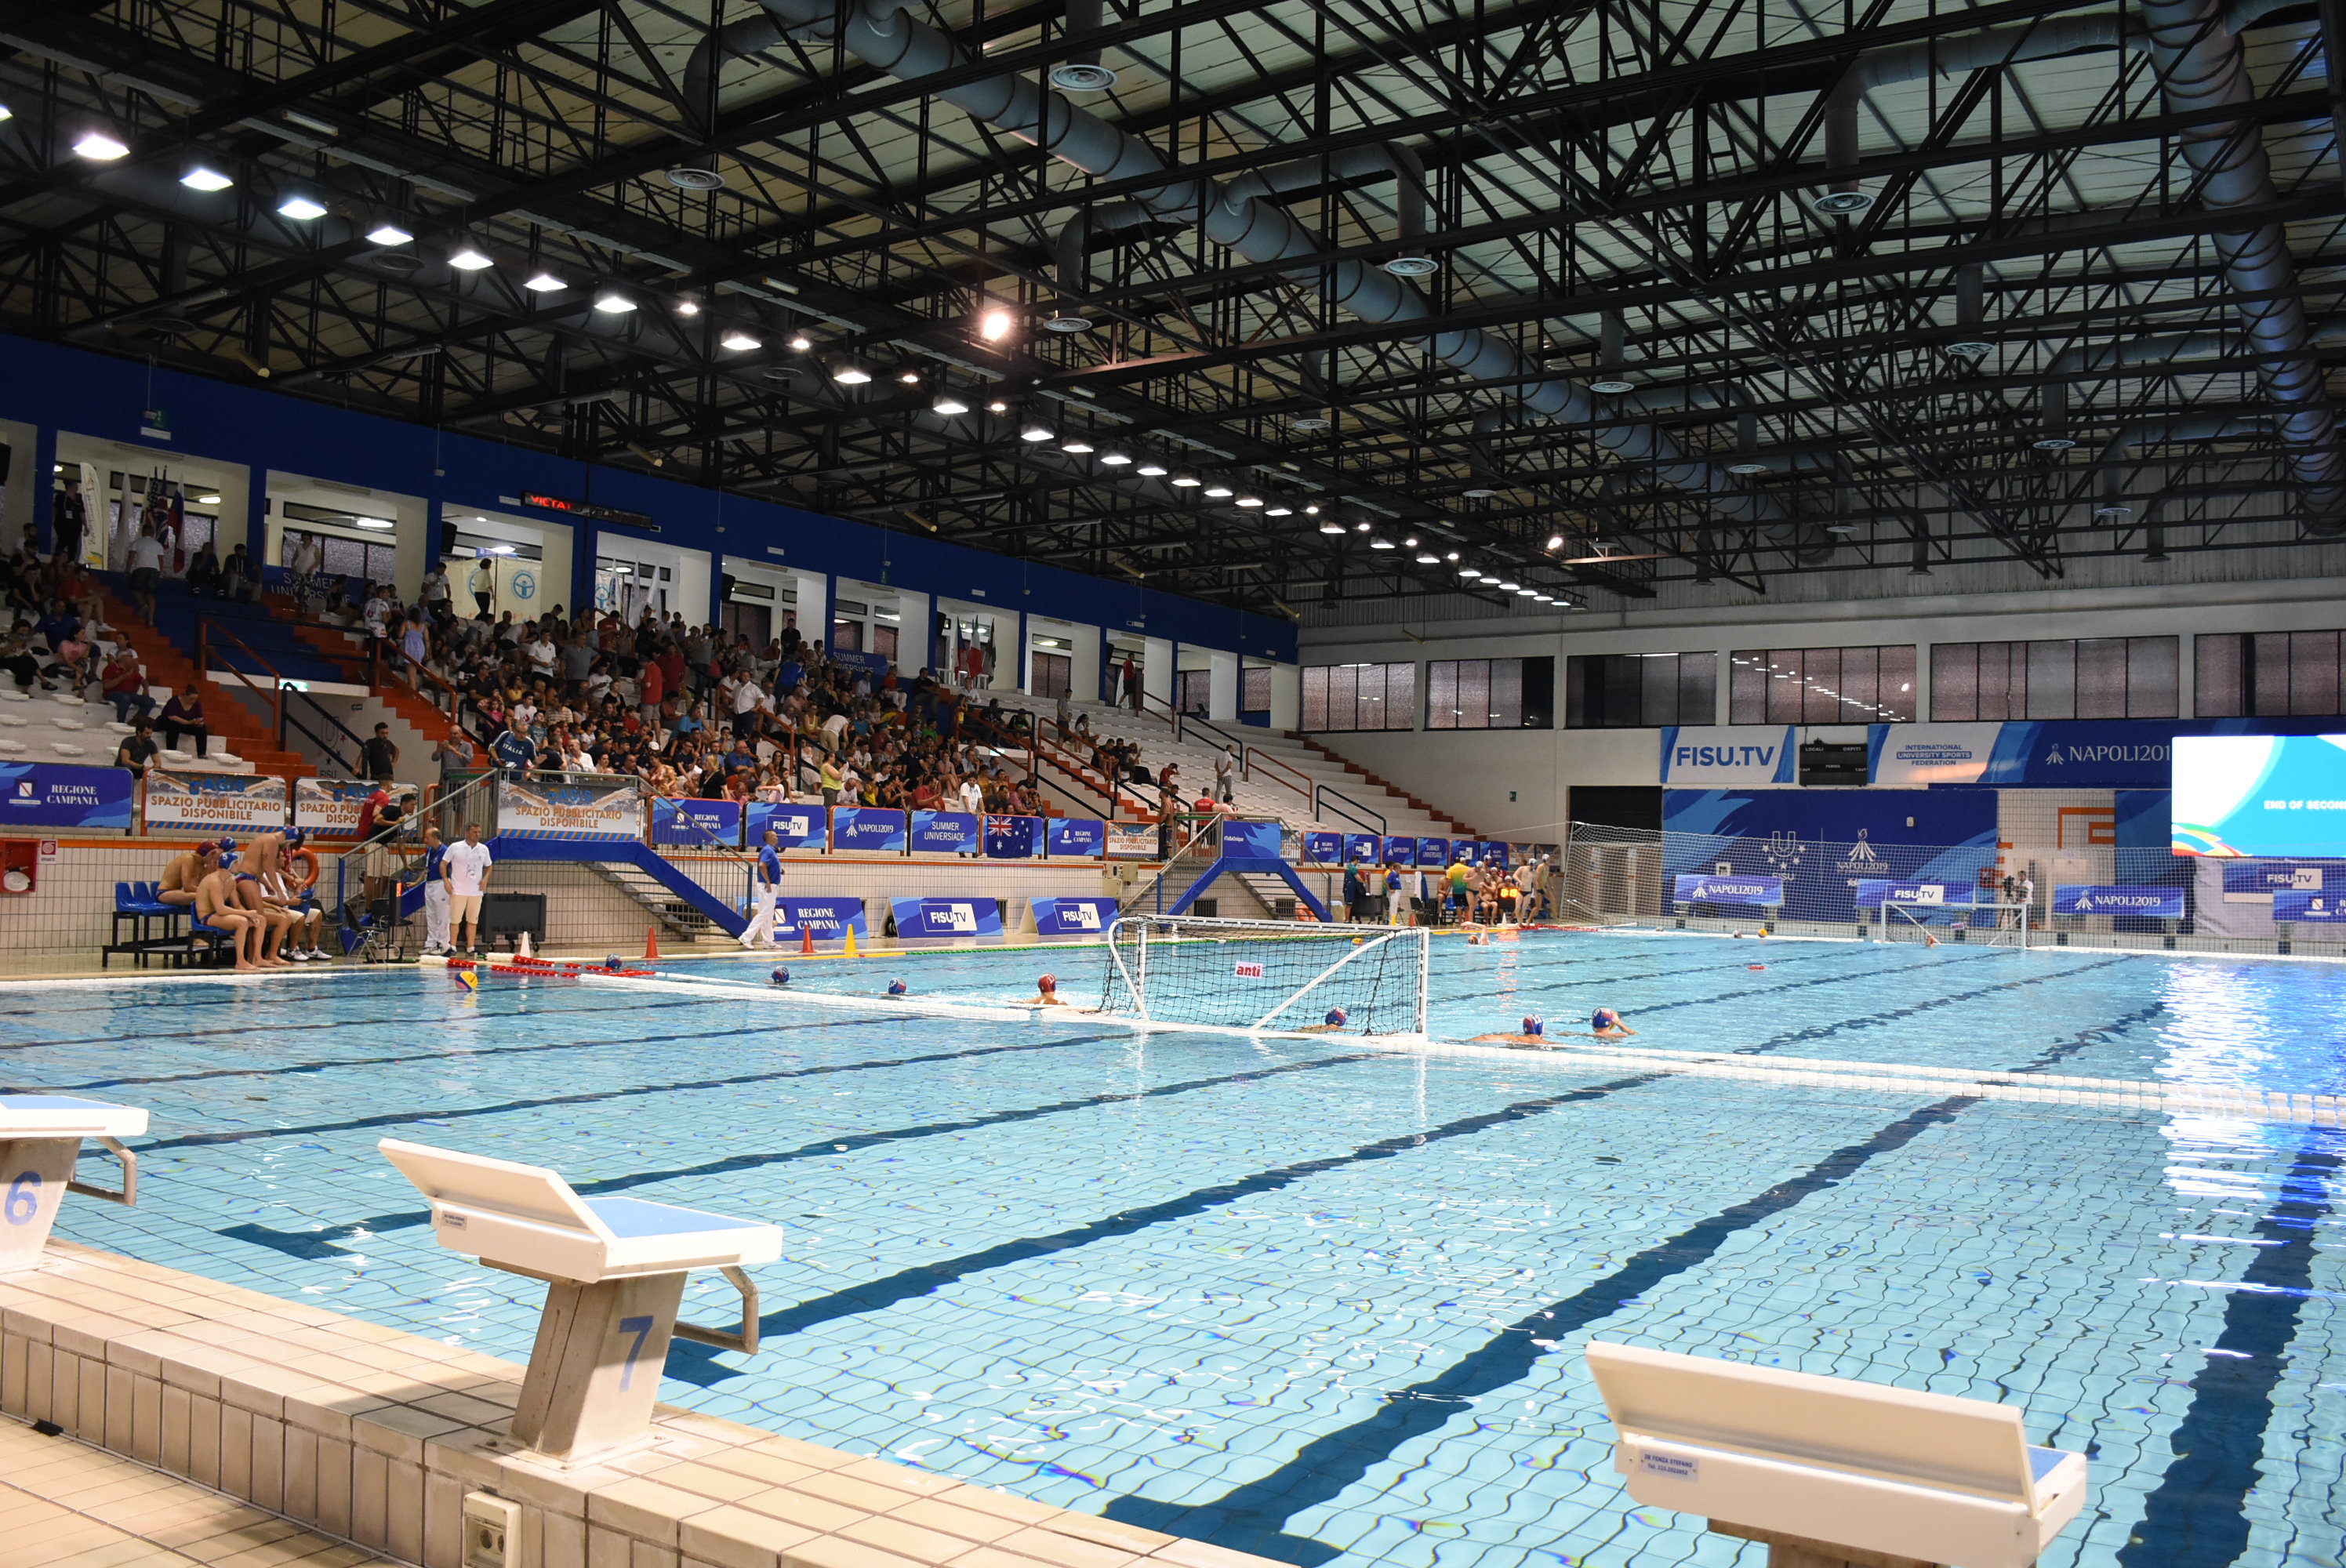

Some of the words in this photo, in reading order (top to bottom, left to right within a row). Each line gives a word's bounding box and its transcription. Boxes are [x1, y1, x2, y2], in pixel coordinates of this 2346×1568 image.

[503, 743, 523, 756] ITALIA
[2069, 745, 2170, 762] NAPOLI201
[1676, 746, 1774, 767] FISU.TV
[52, 784, 96, 795] REGIONE
[202, 778, 245, 793] AGIS
[46, 795, 100, 805] CAMPANIA
[559, 789, 592, 802] AGIS
[151, 795, 194, 808] SPAZIO
[197, 797, 281, 812] PUBBLICITARIO
[300, 803, 337, 813] SPAZIO
[2264, 800, 2286, 809] END
[2289, 800, 2304, 809] OF
[2306, 800, 2346, 809] SECON
[181, 808, 252, 821] DISPONIBILE
[515, 806, 550, 816] SPAZIO
[553, 808, 622, 820] PUBBLICITARIO
[539, 817, 599, 829] DISPONIBILE
[773, 821, 802, 830] FISU.TV
[858, 823, 894, 833] NAPOLI2019
[932, 822, 959, 831] SUMMER
[924, 832, 965, 841] UNIVERSIADE
[2267, 874, 2312, 883] FISU.TV
[1709, 885, 1763, 895] NAPOLI2019
[1894, 890, 1934, 898] FISU.TV
[2094, 895, 2161, 906] NAPOLI2019
[797, 909, 835, 918] REGIONE
[930, 912, 967, 924] FISU.TV
[1062, 910, 1092, 922] FISU.TV
[1236, 965, 1261, 977] anti
[4, 1171, 42, 1226] 6
[619, 1316, 654, 1392] 7
